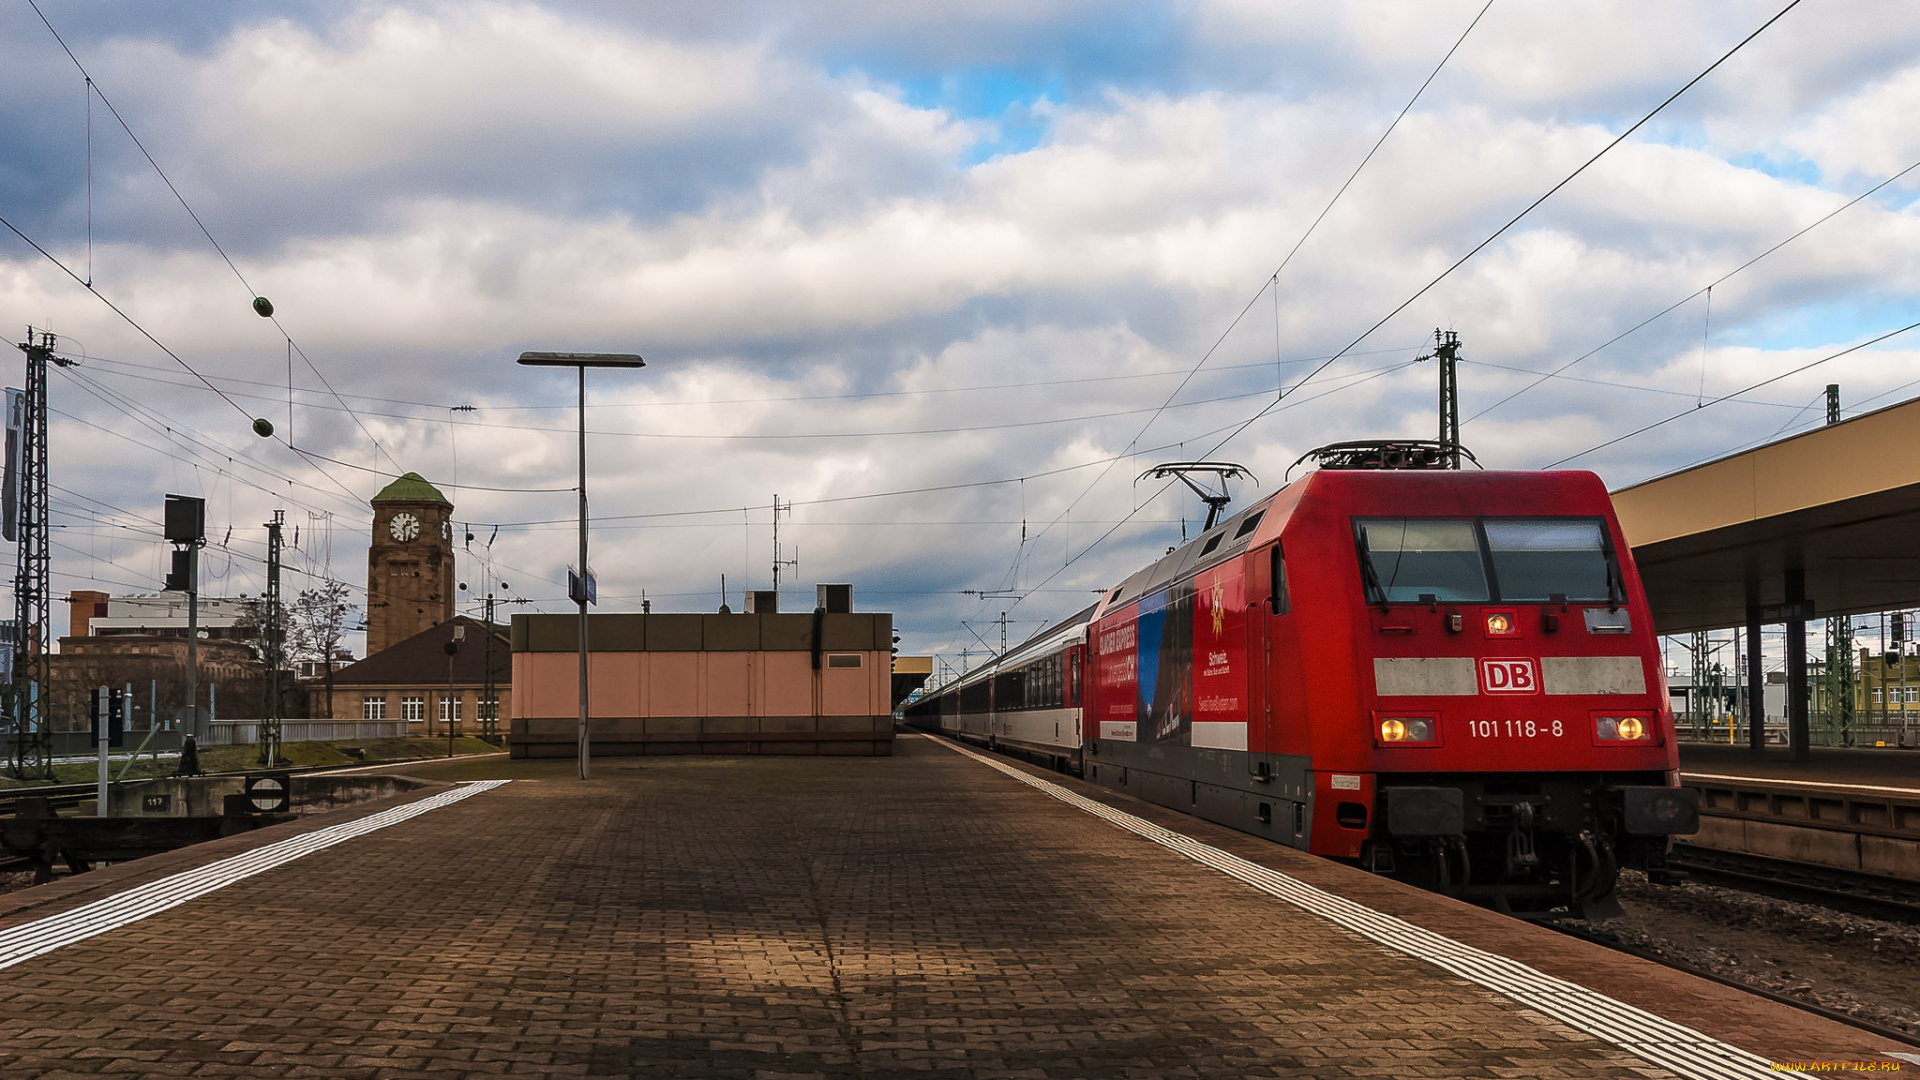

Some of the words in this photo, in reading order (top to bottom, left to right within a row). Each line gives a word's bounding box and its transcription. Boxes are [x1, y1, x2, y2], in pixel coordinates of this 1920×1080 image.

[1116, 624, 1135, 652] EXPRESS
[1487, 663, 1531, 688] DB
[1469, 720, 1499, 738] 101
